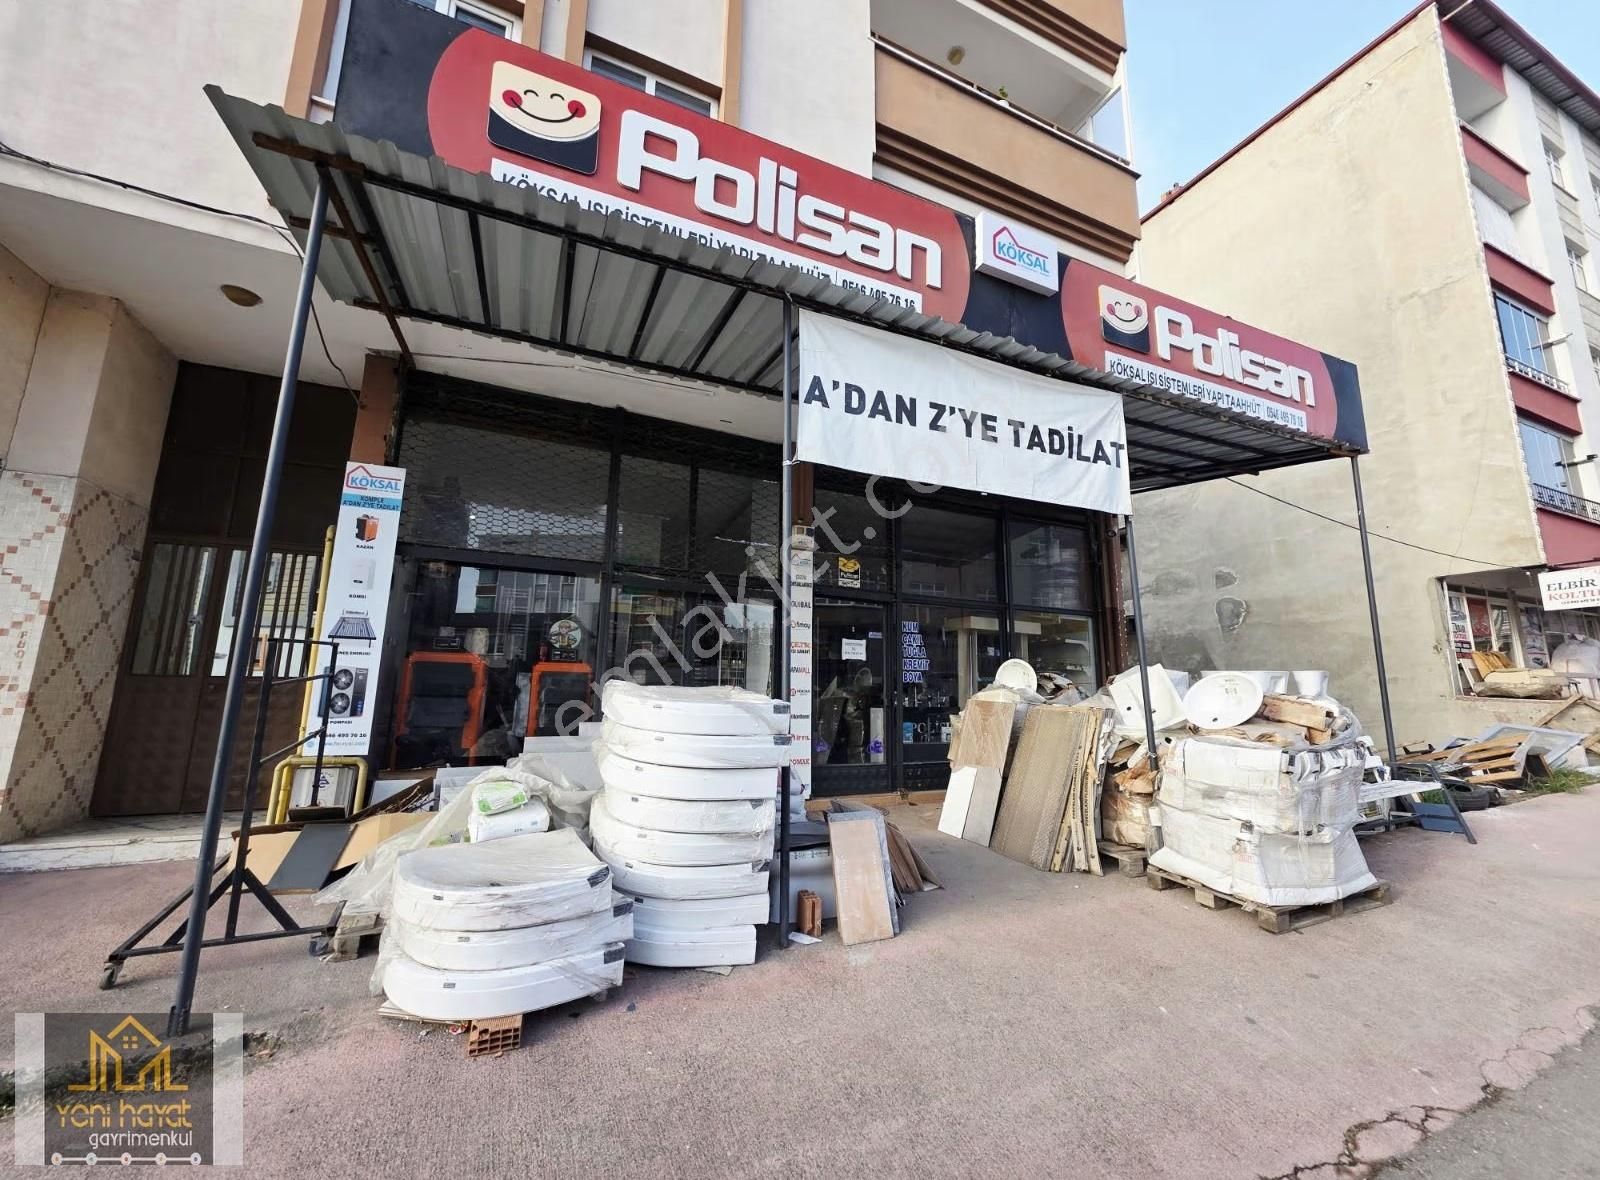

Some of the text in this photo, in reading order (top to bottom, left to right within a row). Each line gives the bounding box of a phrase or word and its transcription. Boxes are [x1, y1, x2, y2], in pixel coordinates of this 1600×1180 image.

[617, 109, 942, 290] Polisan
[998, 240, 1050, 273] KÖKSAL
[1154, 305, 1316, 407] Polisan
[1110, 359, 1146, 381] KÖKSAL
[1158, 372, 1205, 398] SİSTEMLERİ
[1206, 387, 1224, 404] YAPI
[1225, 394, 1261, 414] TAAHHÜT
[803, 375, 1125, 468] A'DAN Z'YE TADİLAT
[350, 475, 401, 491] KÖKSAL
[360, 494, 384, 503] KOMPLE
[1547, 577, 1598, 591] ELBİR
[902, 621, 919, 632] KUM
[902, 634, 924, 646] ÇAKIL
[903, 644, 926, 658] TUĞLA
[903, 659, 930, 670] KREMİT
[903, 672, 923, 683] BOYA
